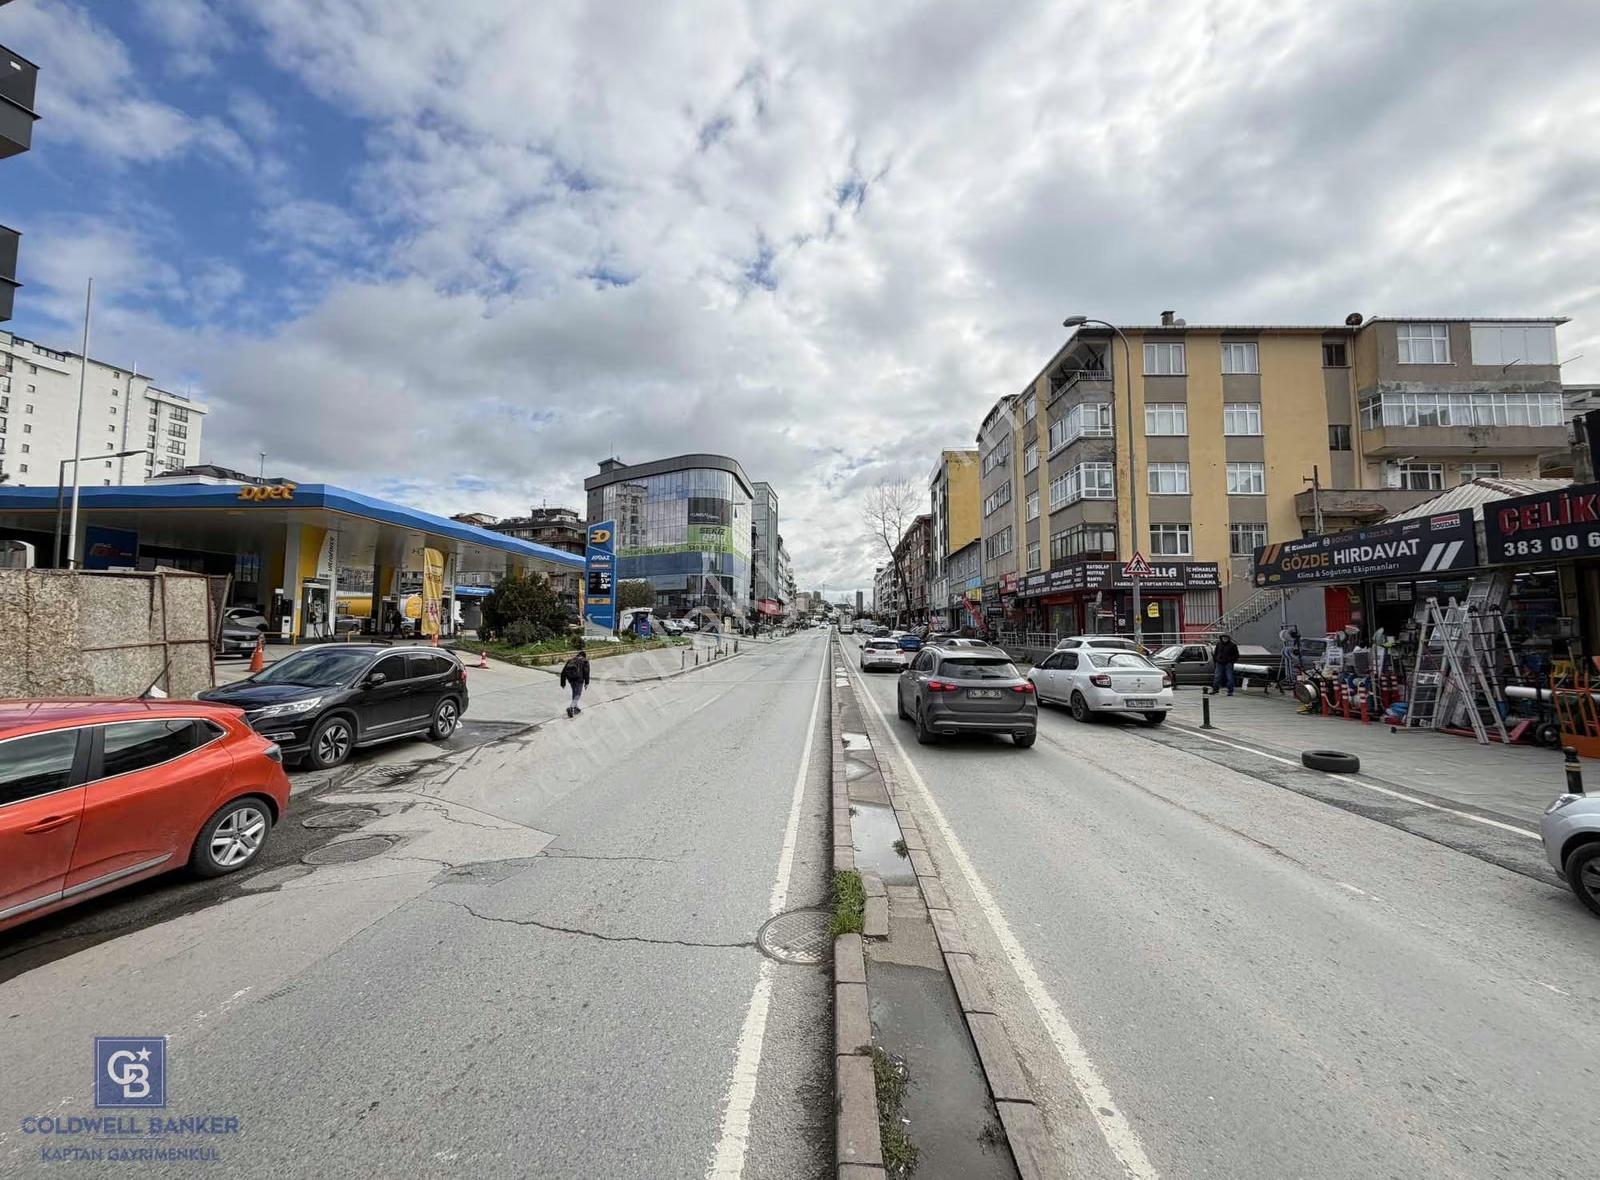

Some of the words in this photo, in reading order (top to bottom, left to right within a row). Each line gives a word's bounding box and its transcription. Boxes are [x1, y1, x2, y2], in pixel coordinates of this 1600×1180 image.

[1498, 494, 1600, 536] ÇELİK
[1281, 552, 1329, 572] GÖZDE
[1333, 538, 1420, 565] HIRDAVAT
[1504, 539, 1543, 556] 383
[1551, 534, 1579, 551] 00
[1297, 571, 1314, 579] Klima
[1353, 562, 1400, 573] Ekipmanları
